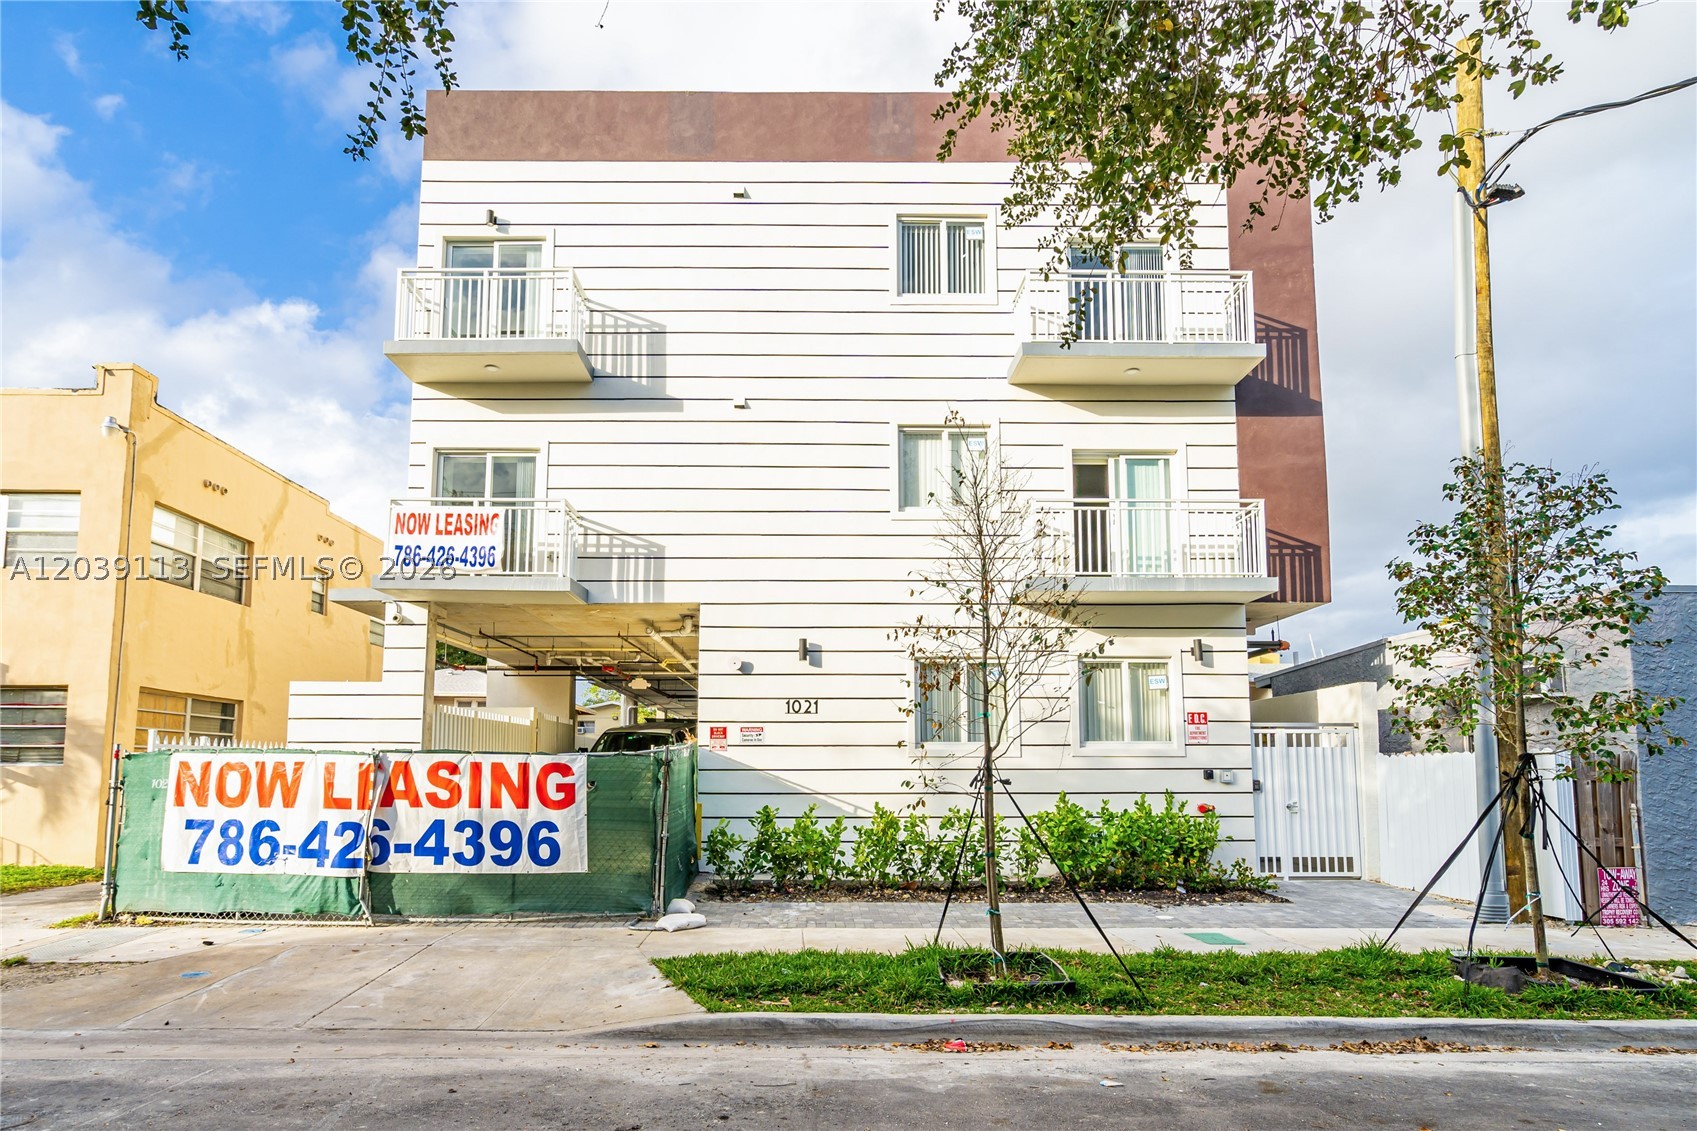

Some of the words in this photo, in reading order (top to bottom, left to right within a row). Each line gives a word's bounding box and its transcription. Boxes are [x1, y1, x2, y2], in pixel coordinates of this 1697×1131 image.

[394, 512, 431, 535] NOW
[435, 513, 500, 536] LEASING
[394, 544, 496, 568] 786-426-4396
[785, 699, 818, 714] 1021
[173, 761, 305, 808] NOW
[323, 760, 576, 811] LEASING
[184, 818, 561, 868] 786-426-4396
